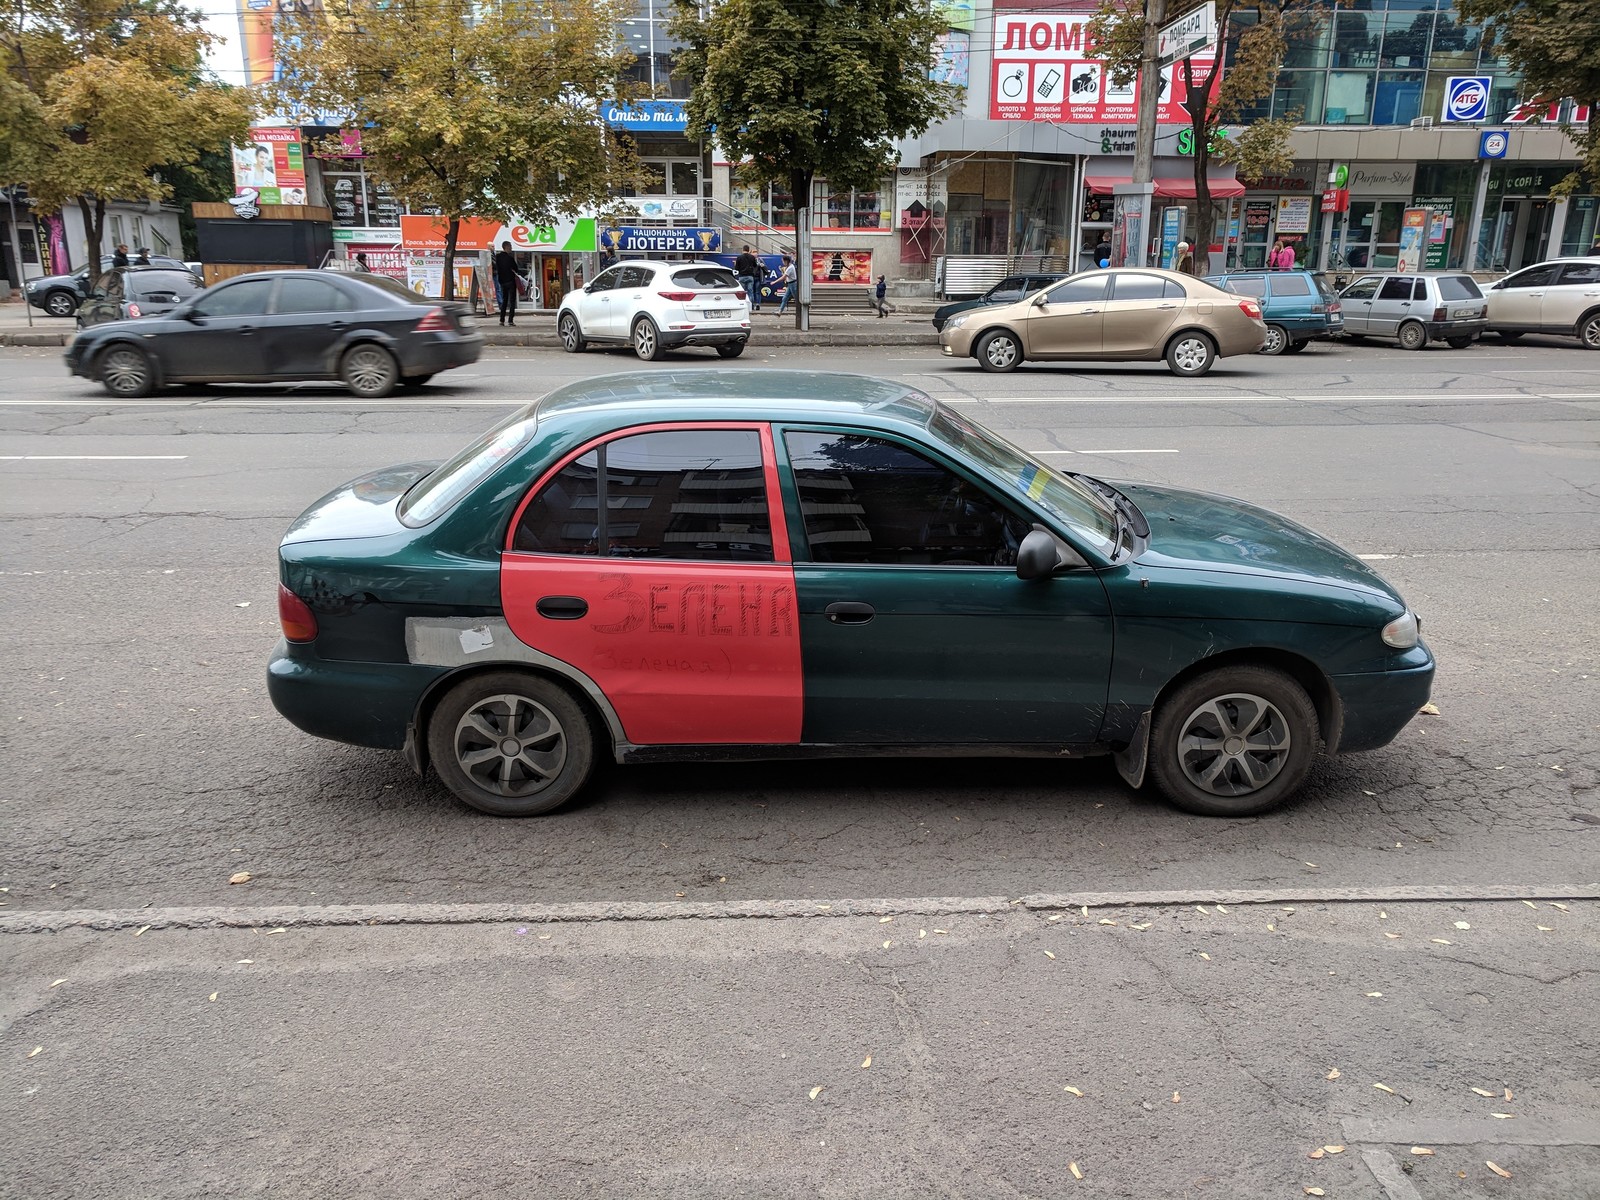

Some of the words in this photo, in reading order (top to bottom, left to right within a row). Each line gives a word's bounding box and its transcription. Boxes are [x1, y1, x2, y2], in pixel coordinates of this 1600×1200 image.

[1169, 14, 1201, 44] ЛОМБАРД
[608, 108, 650, 122] Стиль
[653, 112, 674, 122] та
[1100, 127, 1137, 138] shaurm
[1113, 141, 1136, 151] falaf
[1351, 171, 1413, 186] Parfum-Style
[633, 229, 687, 237] НАЦІОНАЛЬНА
[627, 237, 695, 250] ЛОТЕРЕЯ
